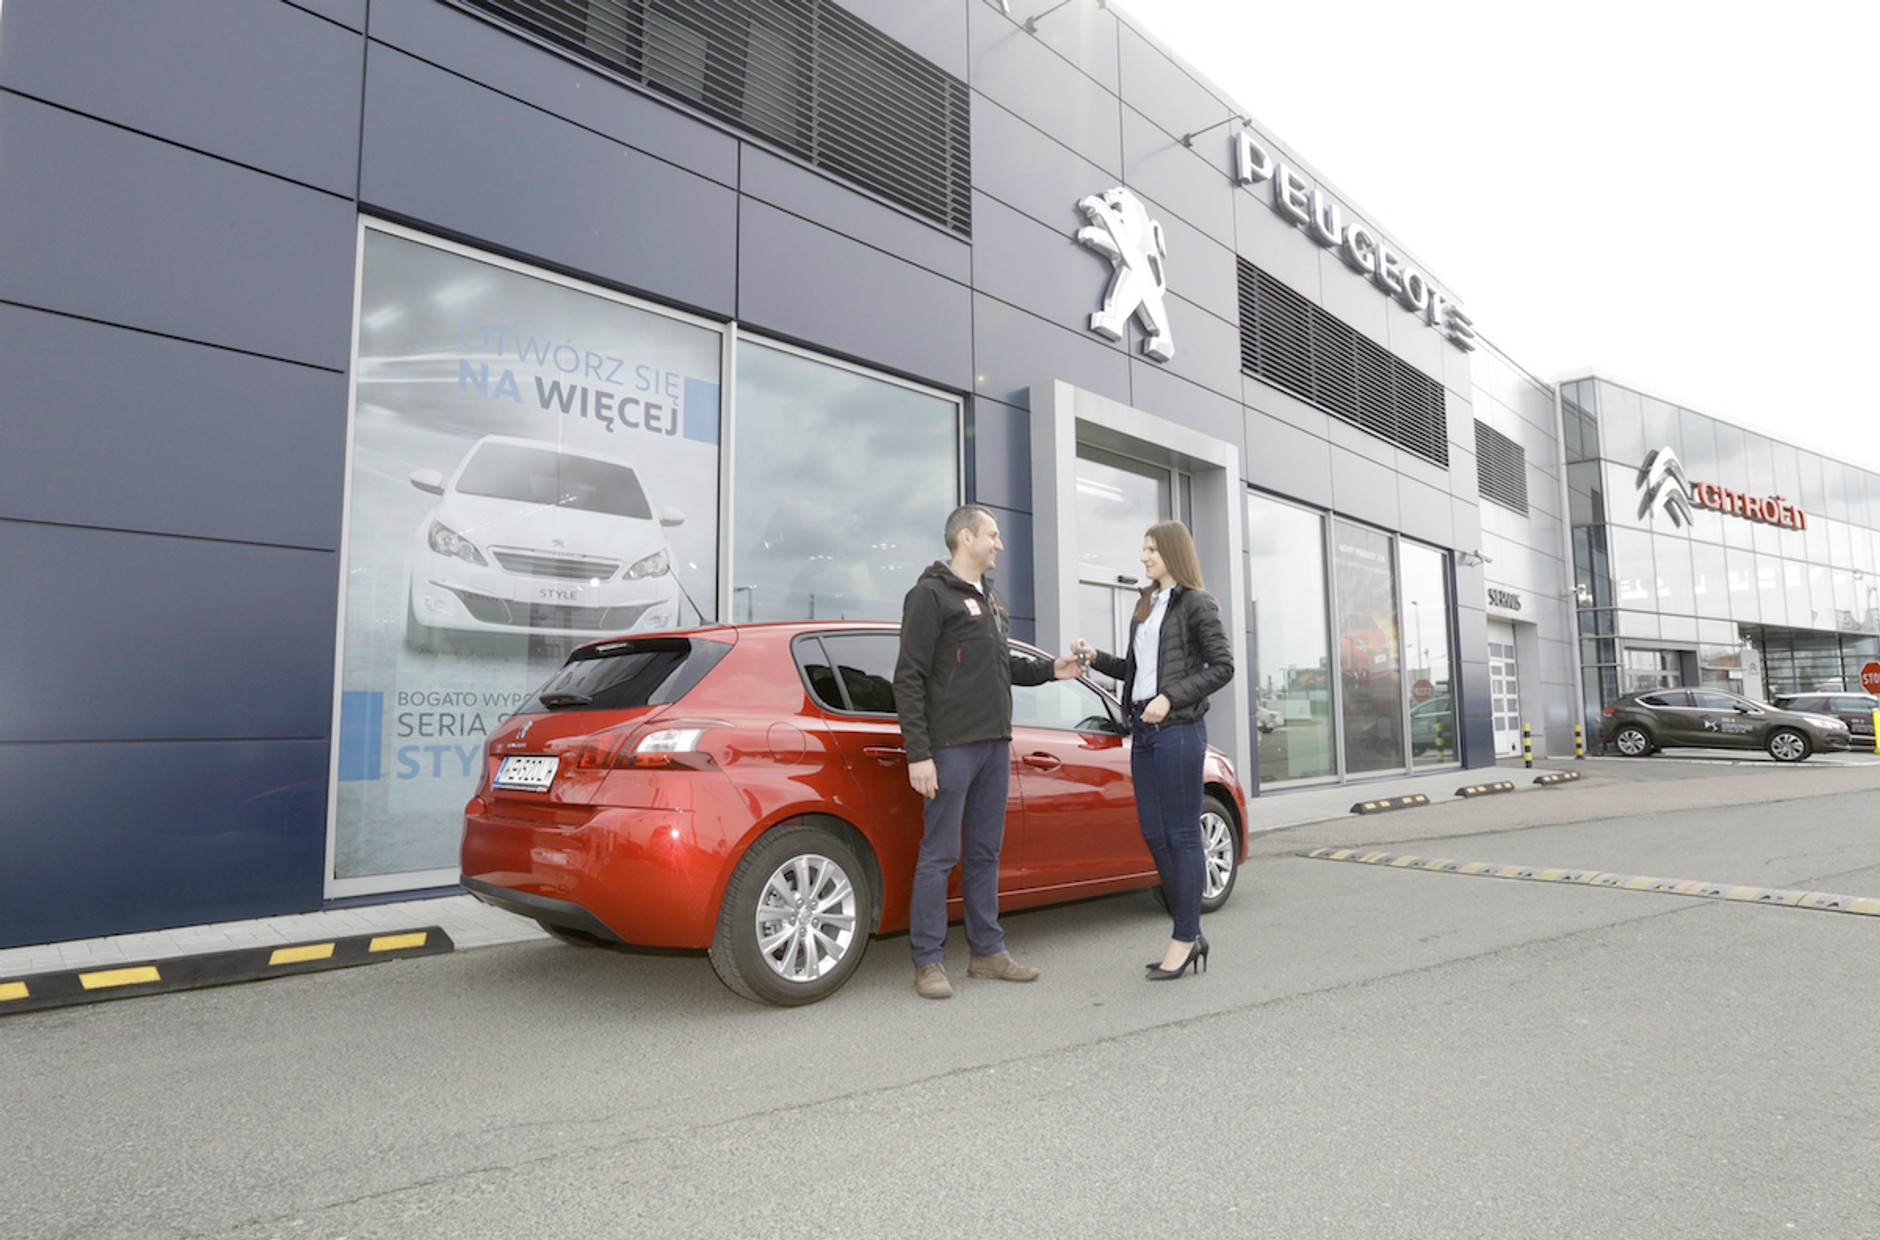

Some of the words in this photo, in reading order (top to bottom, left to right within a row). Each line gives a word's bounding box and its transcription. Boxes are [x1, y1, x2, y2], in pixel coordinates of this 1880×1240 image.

[1234, 131, 1446, 326] PEUGEOT
[459, 321, 625, 386] OTWÓRZ
[635, 364, 680, 406] SIĘ
[457, 358, 524, 405] NA
[535, 376, 679, 437] WIĘCEJ
[539, 588, 578, 601] STYLE
[397, 691, 478, 707] BOGATO
[397, 712, 487, 738] SERIA
